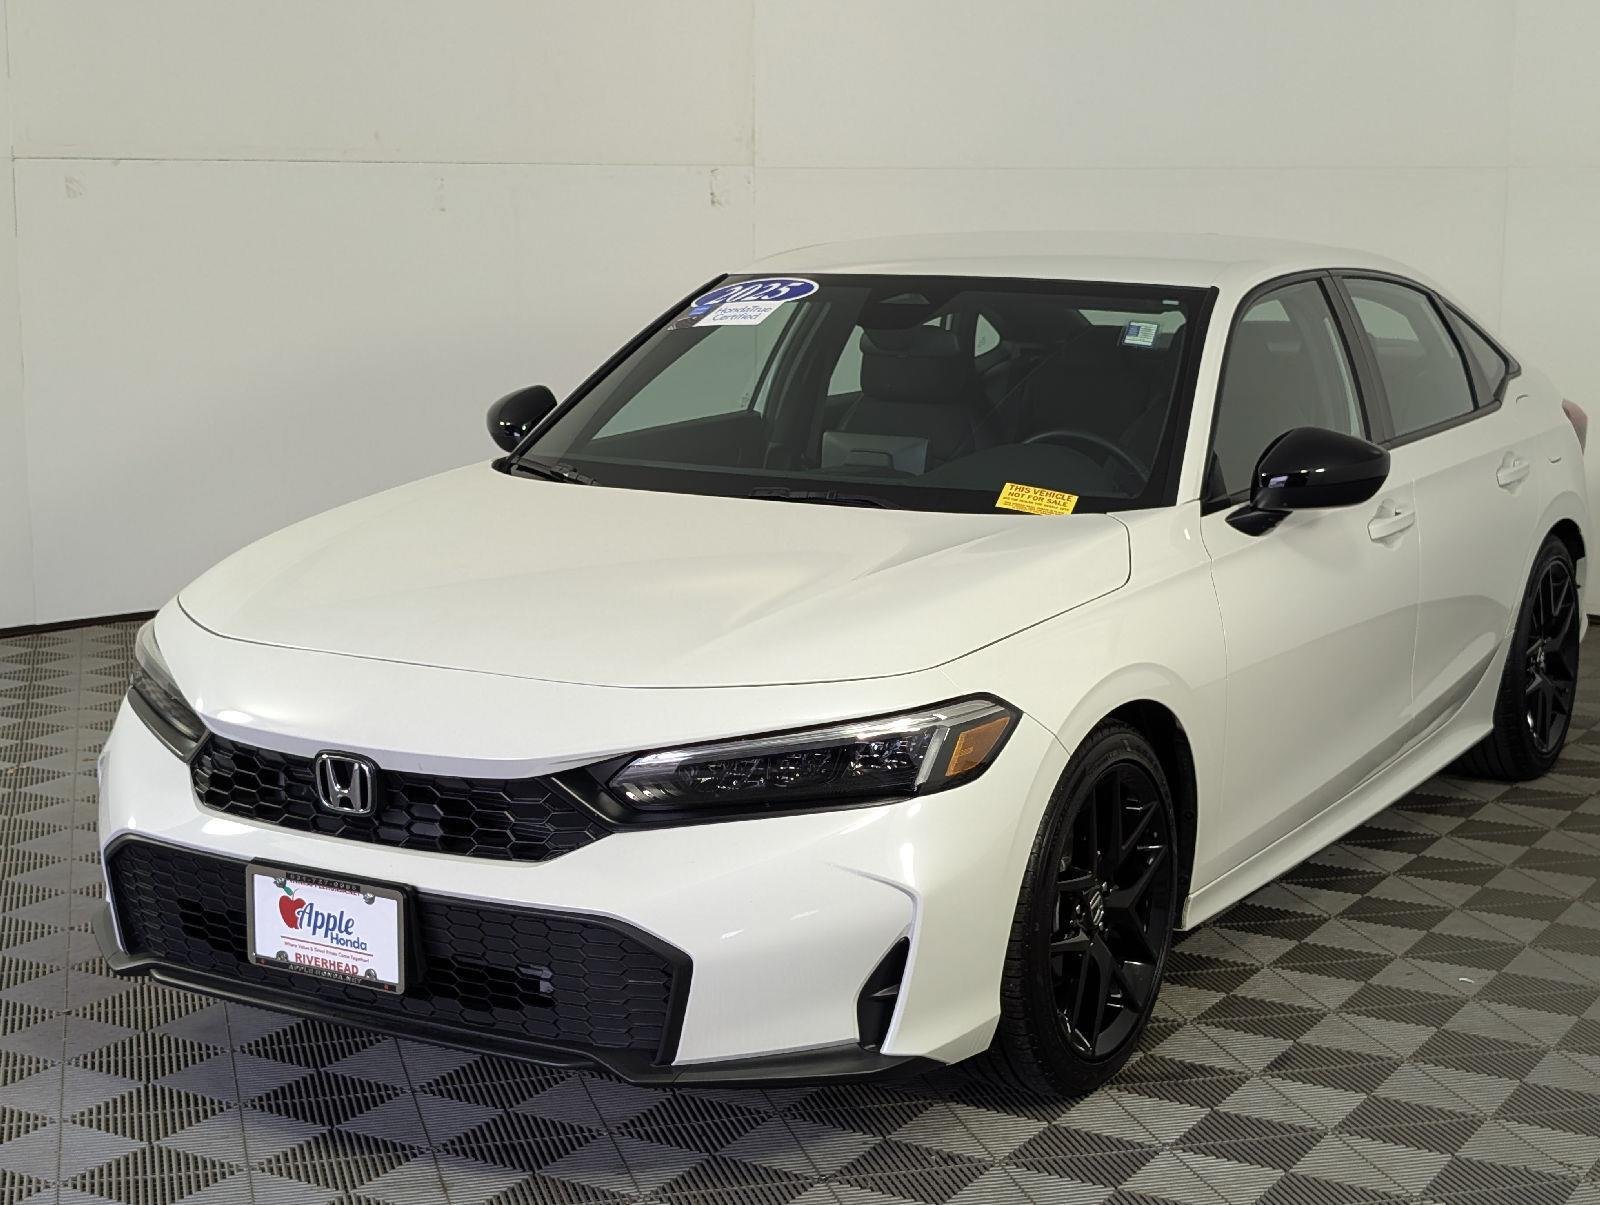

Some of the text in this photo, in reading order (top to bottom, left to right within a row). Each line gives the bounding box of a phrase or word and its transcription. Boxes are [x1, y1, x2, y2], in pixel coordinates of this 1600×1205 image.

[699, 283, 804, 303] 2025
[712, 313, 762, 321] Certified
[1007, 491, 1025, 499] NOT
[1026, 493, 1044, 502] FOR
[1046, 498, 1069, 507] SALE
[1009, 484, 1074, 502] THIS VEHICLE
[297, 902, 355, 938] Apple
[330, 932, 368, 951] Honda
[294, 952, 359, 976] RIVERHEAD
